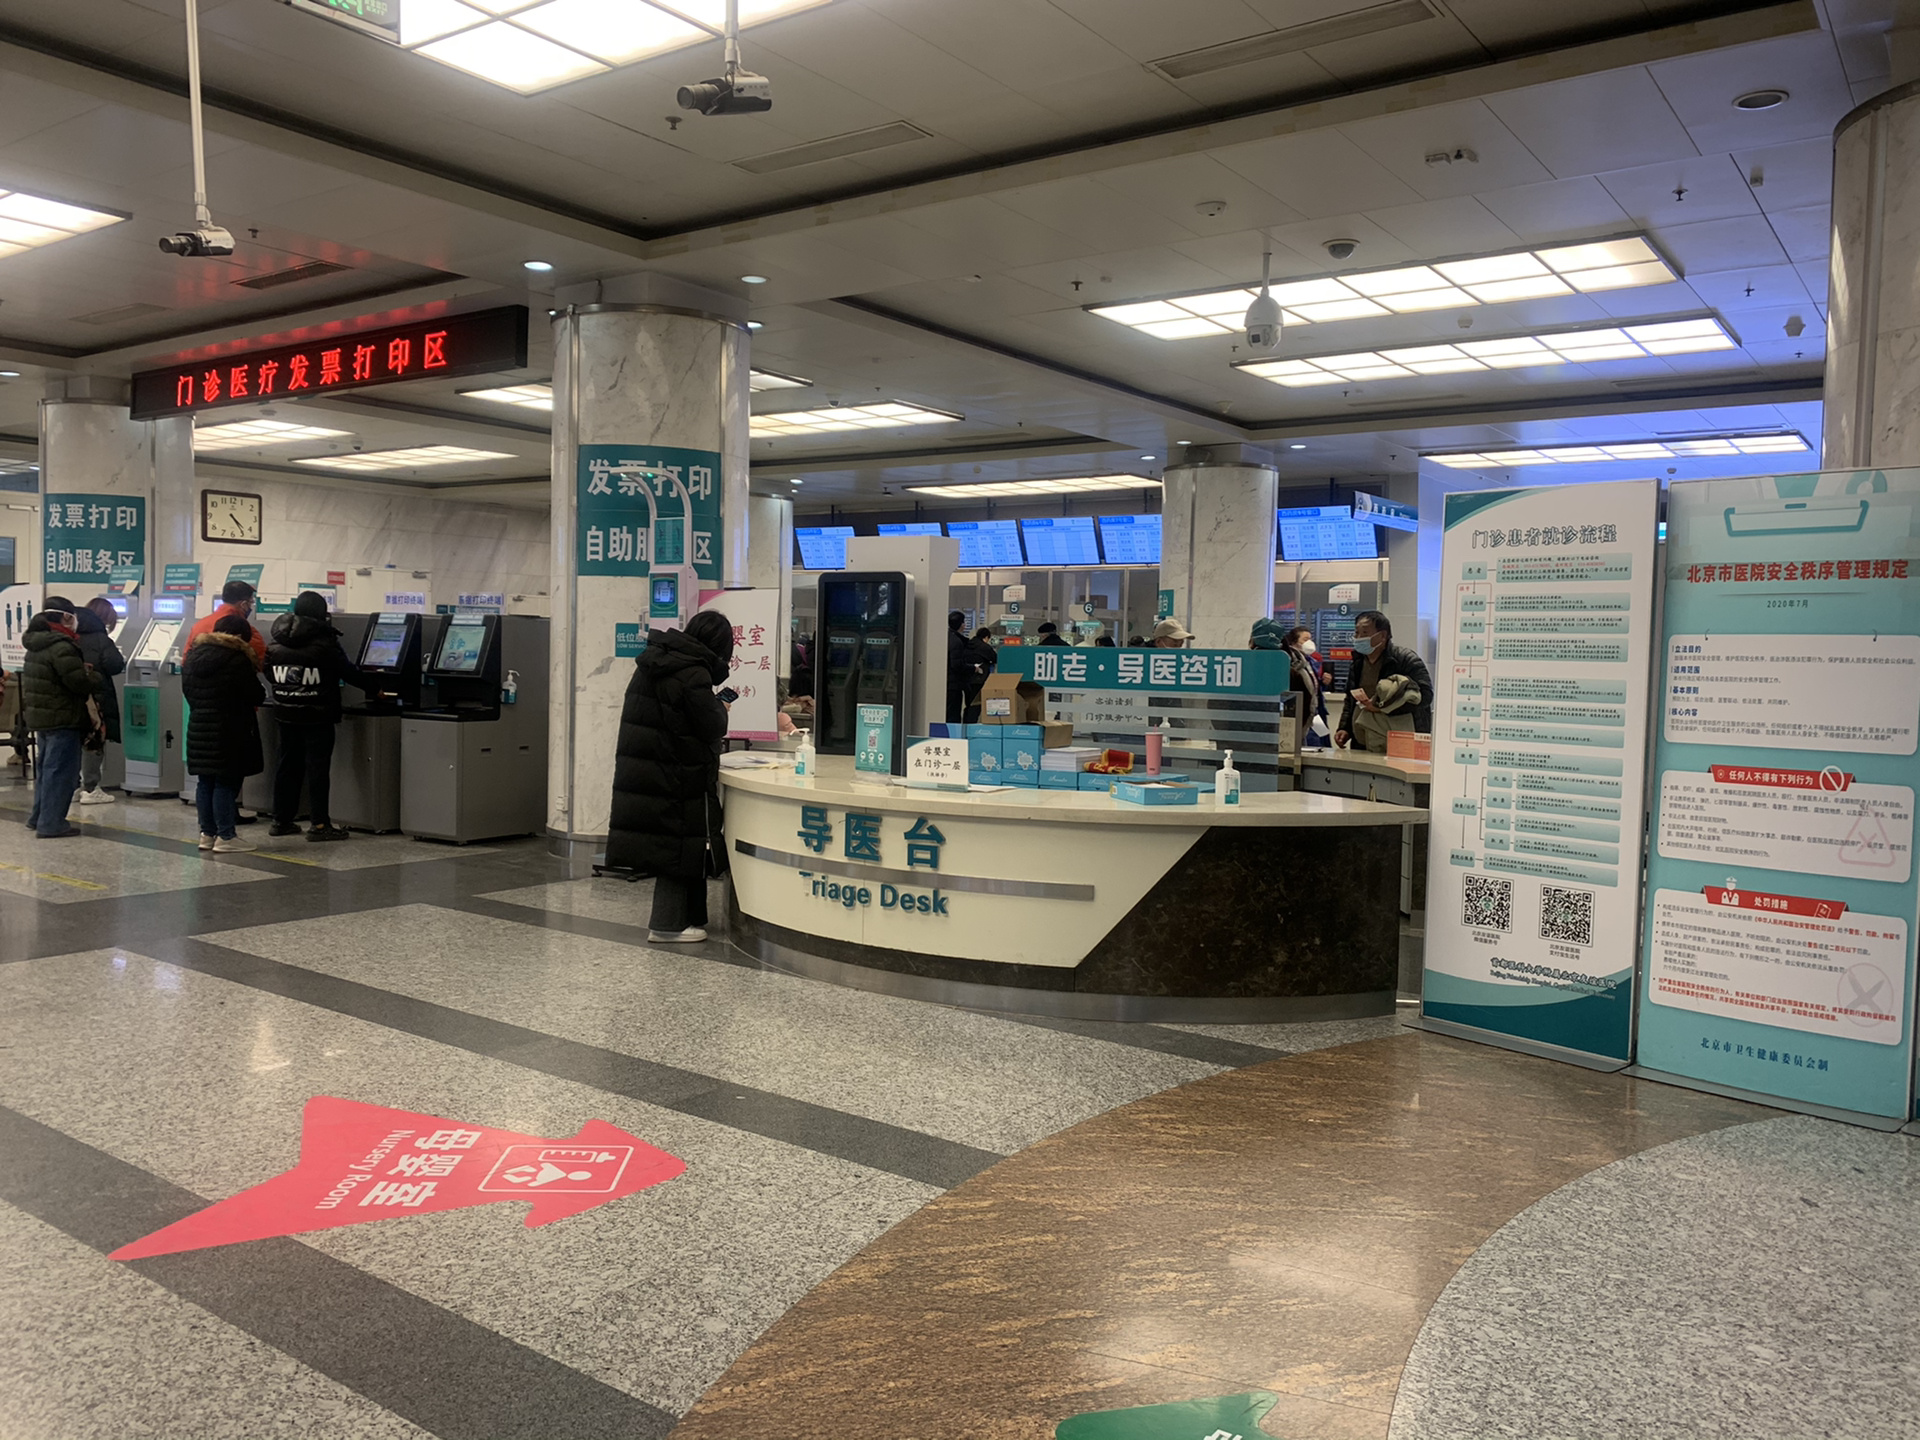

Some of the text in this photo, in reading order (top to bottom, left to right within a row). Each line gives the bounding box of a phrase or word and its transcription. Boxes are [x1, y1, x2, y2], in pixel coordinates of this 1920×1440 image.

[176, 330, 448, 407] 门诊医疗发票打印区
[587, 458, 712, 500] 发票打印
[48, 503, 137, 530] 发票打印
[586, 525, 713, 565] 自助服区
[1472, 524, 1617, 549] 门诊患者就诊流程
[46, 548, 135, 574] 自助服务区
[1687, 559, 1909, 583] 北京市医院安全秩序管理规定
[1010, 603, 1018, 612] 5
[1085, 603, 1093, 612] 6
[1340, 605, 1347, 614] 9
[1767, 599, 1808, 608] 2020年7月
[1033, 652, 1242, 687] 助老·导医咨询
[1085, 712, 1143, 723] 门诊服务中心
[914, 757, 961, 770] 在门诊一层
[923, 746, 951, 756] 母婴室
[1729, 770, 1814, 785] 任何人不得有下列行为
[797, 805, 947, 869] 导医台
[799, 871, 949, 915] riage Desk
[1754, 897, 1789, 910] 处罚措施
[1701, 1037, 1830, 1072] 北京市卫生健康委员会制
[314, 1129, 416, 1211] Nursery Room
[358, 1128, 483, 1208] 母婴室
